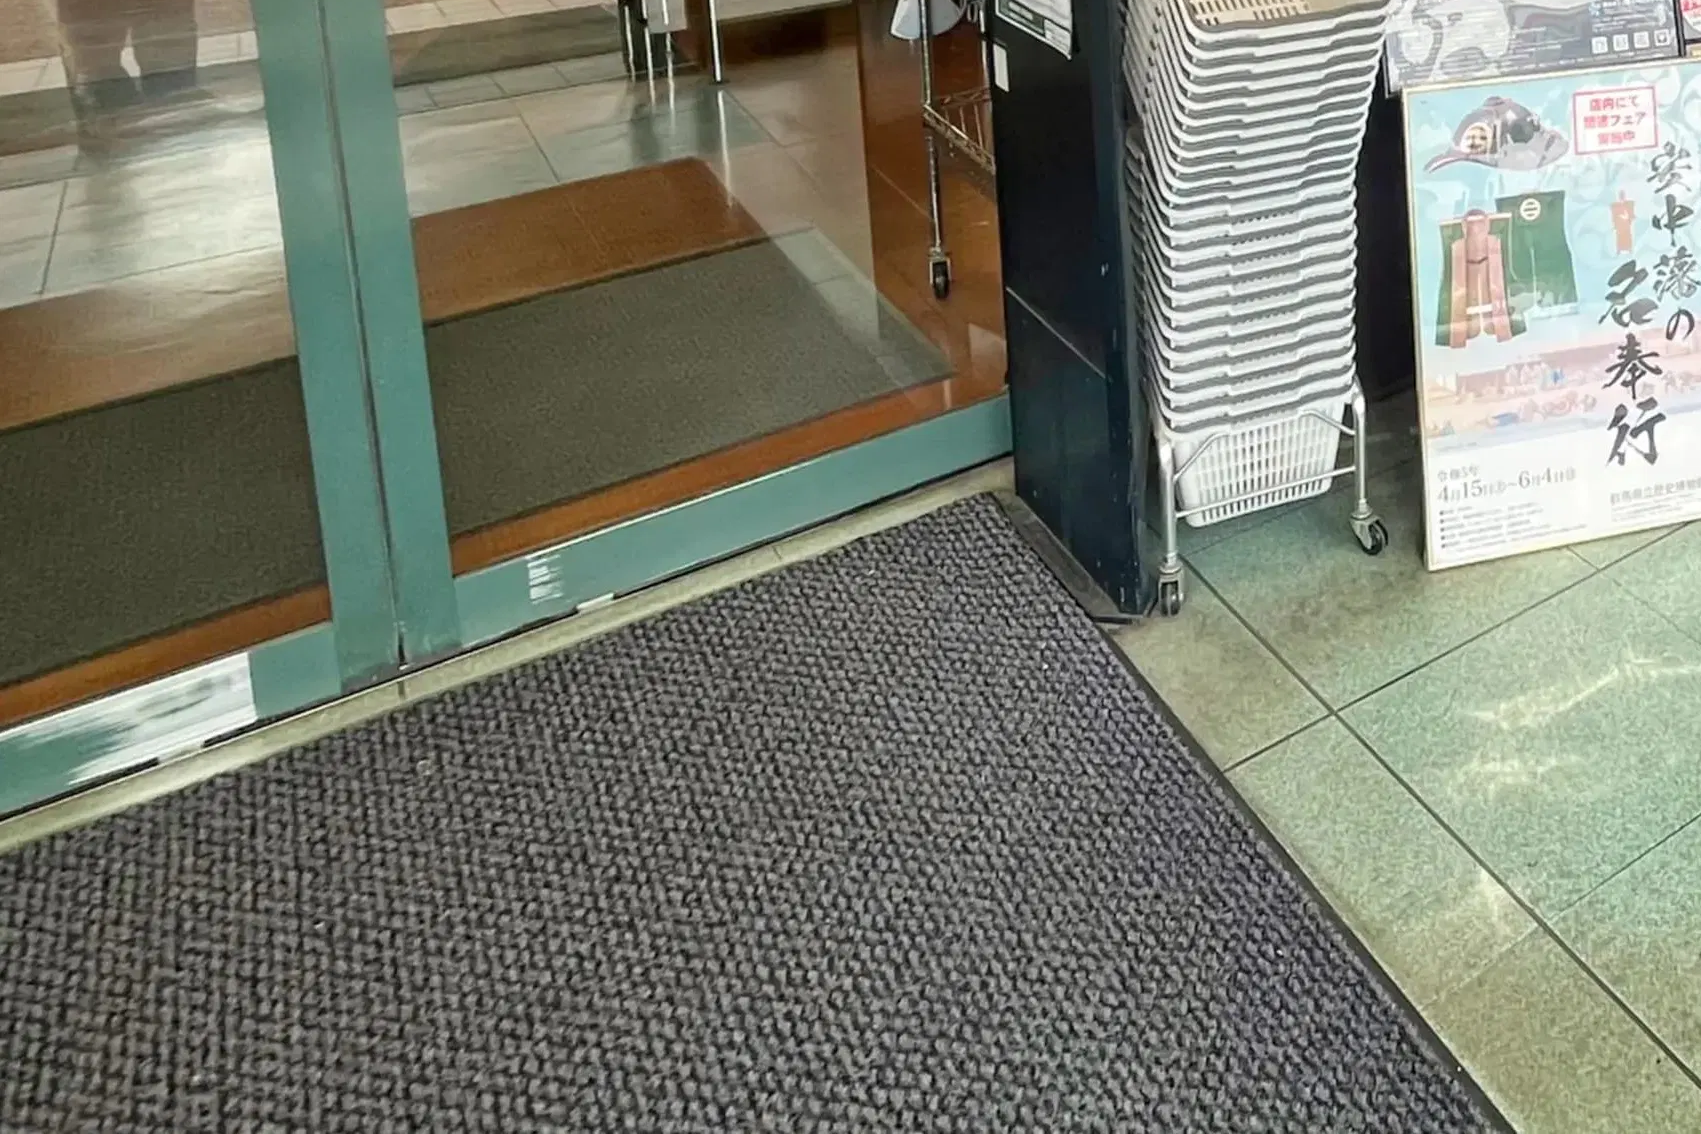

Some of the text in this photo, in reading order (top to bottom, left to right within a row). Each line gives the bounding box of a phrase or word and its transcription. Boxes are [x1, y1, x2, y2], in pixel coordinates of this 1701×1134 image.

[1646, 140, 1701, 341] 安中藩の
[1598, 259, 1666, 468] 名奉行
